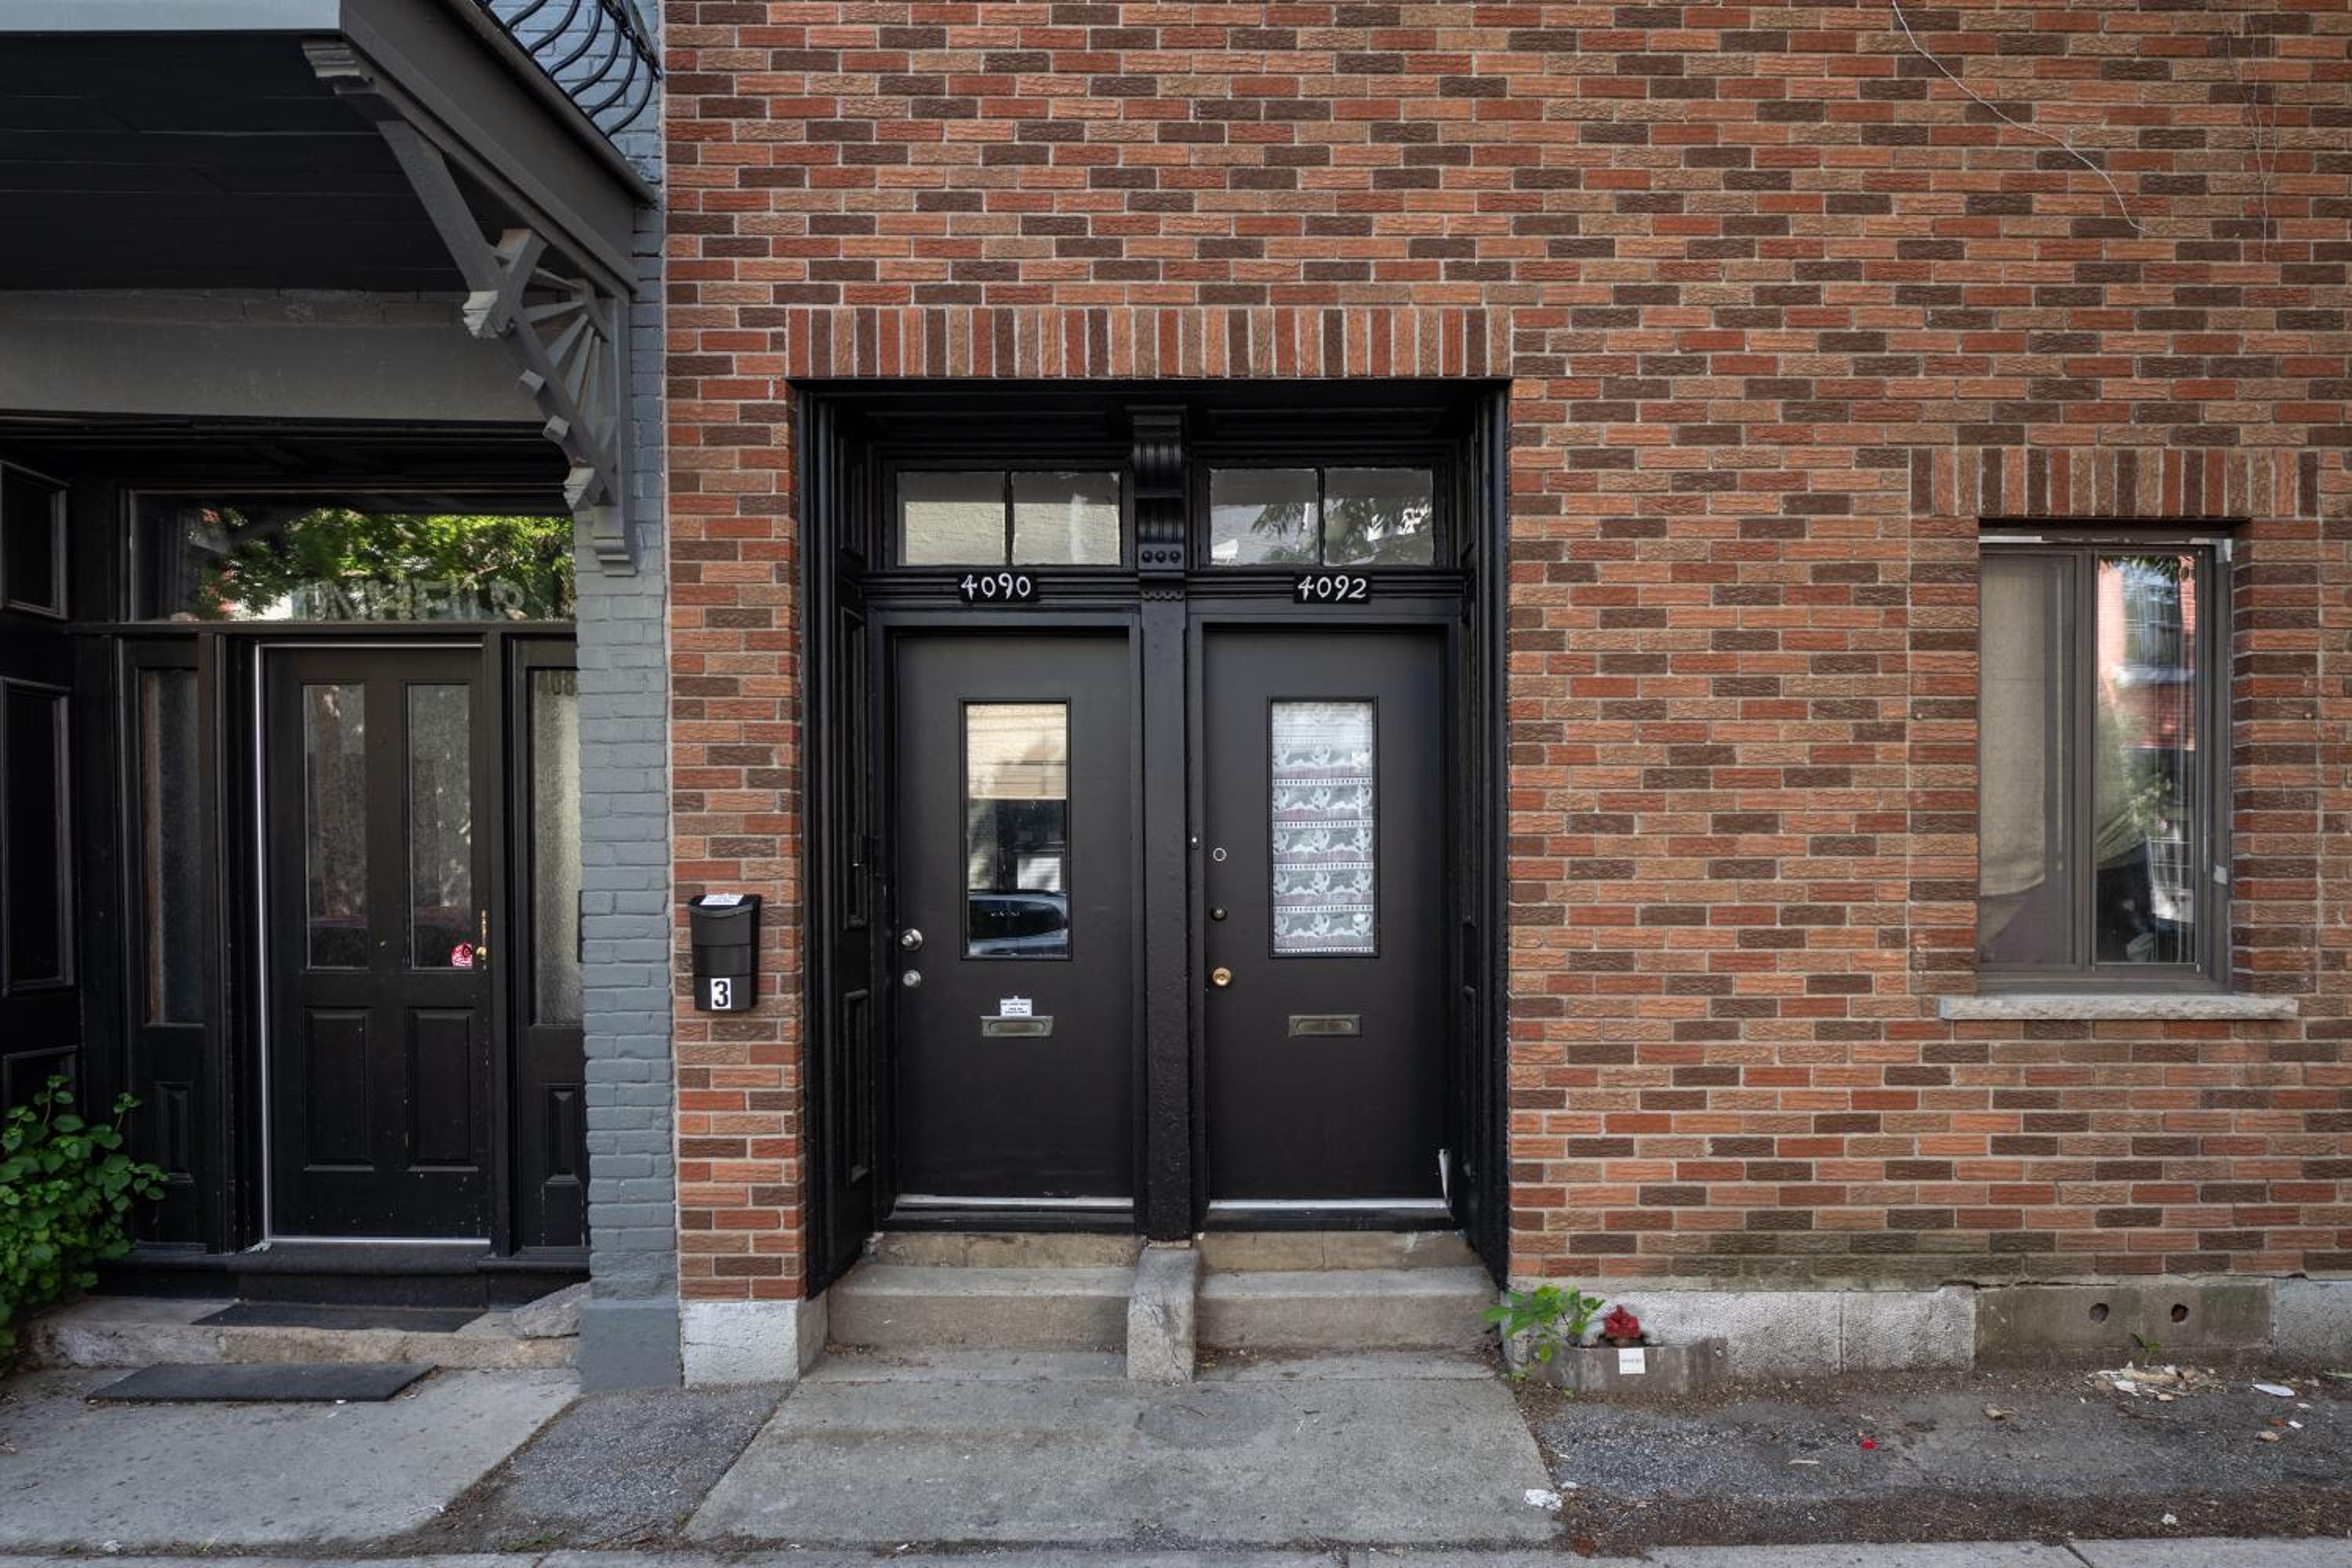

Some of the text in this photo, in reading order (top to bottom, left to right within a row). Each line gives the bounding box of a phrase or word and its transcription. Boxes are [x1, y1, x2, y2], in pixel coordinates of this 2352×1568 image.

[960, 572, 1031, 600] 4090
[1298, 575, 1367, 601] 4092
[714, 981, 728, 1007] 3
